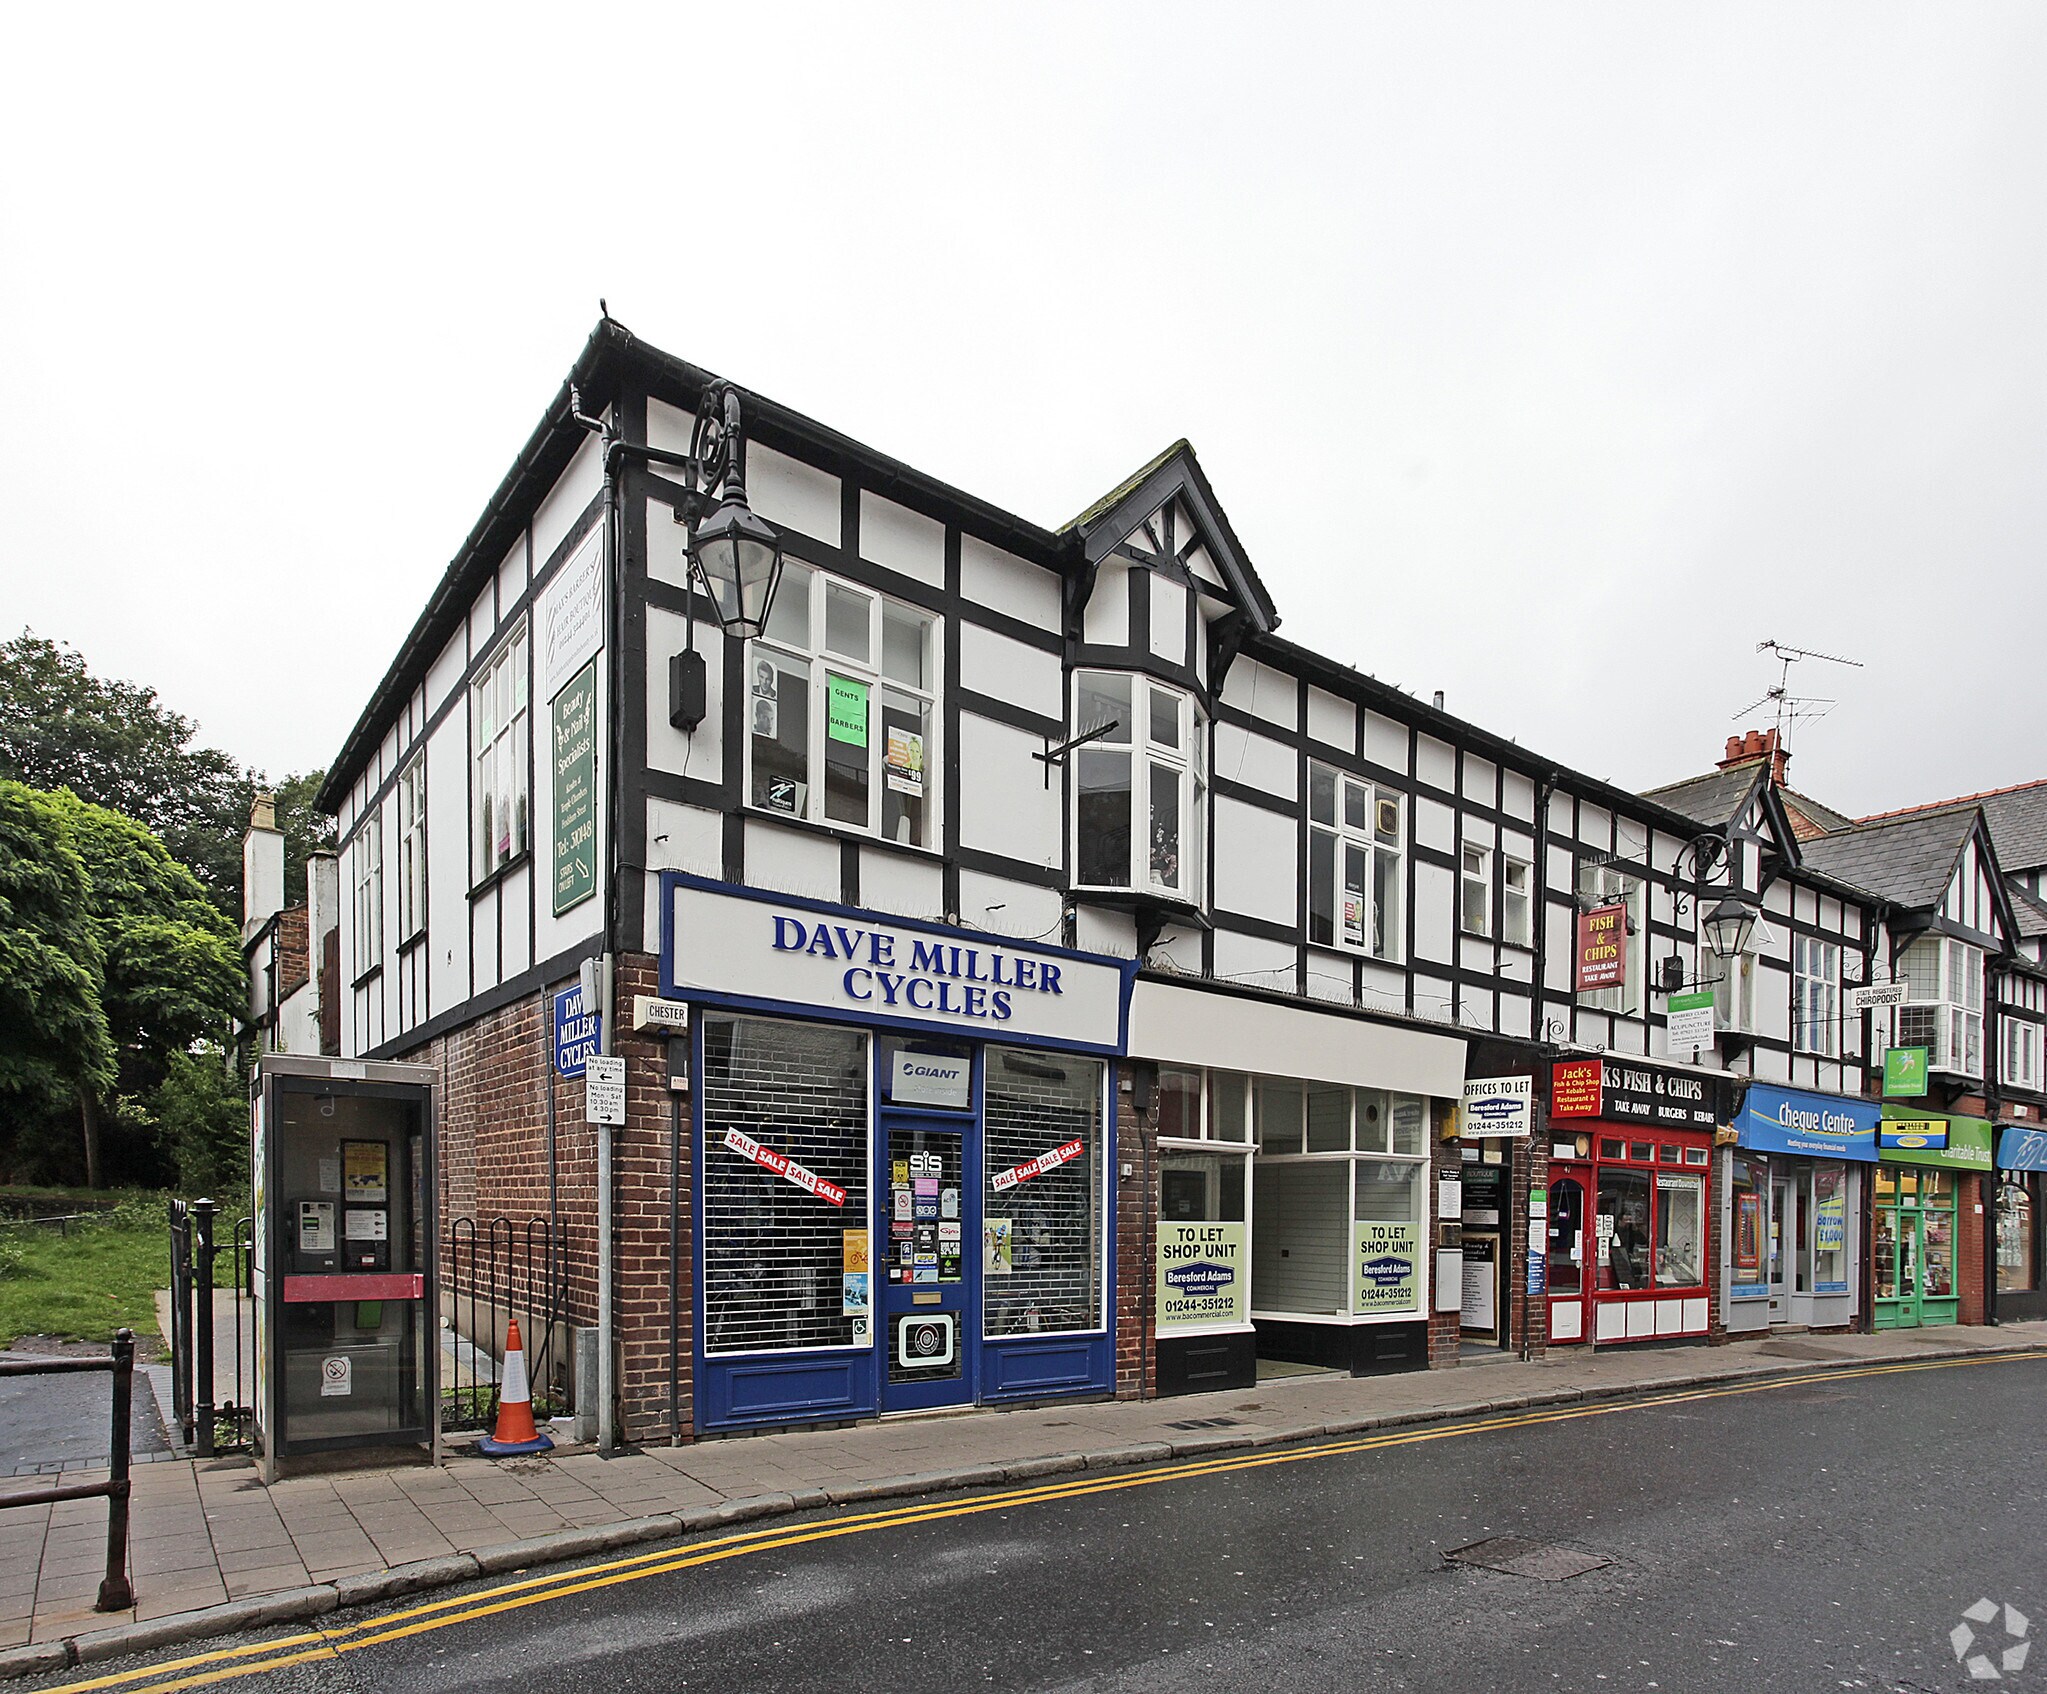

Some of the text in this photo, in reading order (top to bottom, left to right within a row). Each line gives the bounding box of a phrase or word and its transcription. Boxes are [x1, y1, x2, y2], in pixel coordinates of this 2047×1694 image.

[835, 688, 859, 702] GENTS
[563, 690, 584, 720] Beauty
[571, 713, 583, 738] Nail
[830, 717, 864, 733] BARBERS
[558, 738, 590, 776] Specialists
[557, 838, 569, 858] Tel:
[1589, 915, 1614, 932] FISH
[1596, 932, 1605, 945] &
[772, 915, 1063, 995] DAVE MILLER
[1585, 944, 1617, 962] CHIPS
[1582, 961, 1618, 974] RESTAURANT
[1584, 971, 1616, 982] TAKE AWAY
[843, 967, 1012, 1020] CYCLES
[1872, 986, 1902, 995] REGISTERED
[566, 992, 583, 1019] DAV
[1856, 993, 1902, 1006] CHIROPODIST
[649, 1004, 685, 1020] CHESTER
[559, 1016, 596, 1046] MILLER
[1671, 1020, 1711, 1030] ACUPUNCTURE
[560, 1040, 596, 1069] CYCLES
[600, 1059, 622, 1067] loading
[915, 1066, 960, 1079] GIANT
[1562, 1067, 1592, 1079] Jack's
[600, 1085, 623, 1093] loading
[1464, 1081, 1529, 1096] OFFICES TO LET
[1623, 1069, 1652, 1093] FISH
[1655, 1074, 1665, 1094] &
[1667, 1077, 1702, 1100] CHIPS
[1557, 1094, 1595, 1103] Restaurant &
[1470, 1102, 1521, 1111] Beresford Adams
[1614, 1100, 1630, 1113] TAKE
[1631, 1103, 1651, 1115] AWAY
[1658, 1106, 1687, 1120] BURGERS
[1694, 1110, 1714, 1124] KEBABS
[1779, 1101, 1855, 1135] Cheque Centre
[1468, 1121, 1523, 1130] 01244-351212
[1940, 1144, 1991, 1162] Charitable Trust
[728, 1133, 843, 1202] SALE SALE SALE SALE
[995, 1142, 1081, 1187] SALE SALE SALE SALE
[1817, 1214, 1842, 1226] Borrow
[1177, 1228, 1224, 1241] TO LET
[1371, 1227, 1406, 1239] TO LET
[1819, 1229, 1843, 1243] £1,000
[1163, 1244, 1237, 1259] SHOP UNIT
[1361, 1241, 1413, 1253] SHOP UNIT
[1168, 1270, 1232, 1283] Beresford Adams
[1363, 1264, 1410, 1275] Beresford Adams
[1361, 1287, 1411, 1299] 01244-351212
[1165, 1297, 1234, 1312] 01244-351212
[1361, 1299, 1411, 1307] www.bacommercial.com
[1166, 1310, 1233, 1320] www.bacommercial.com
